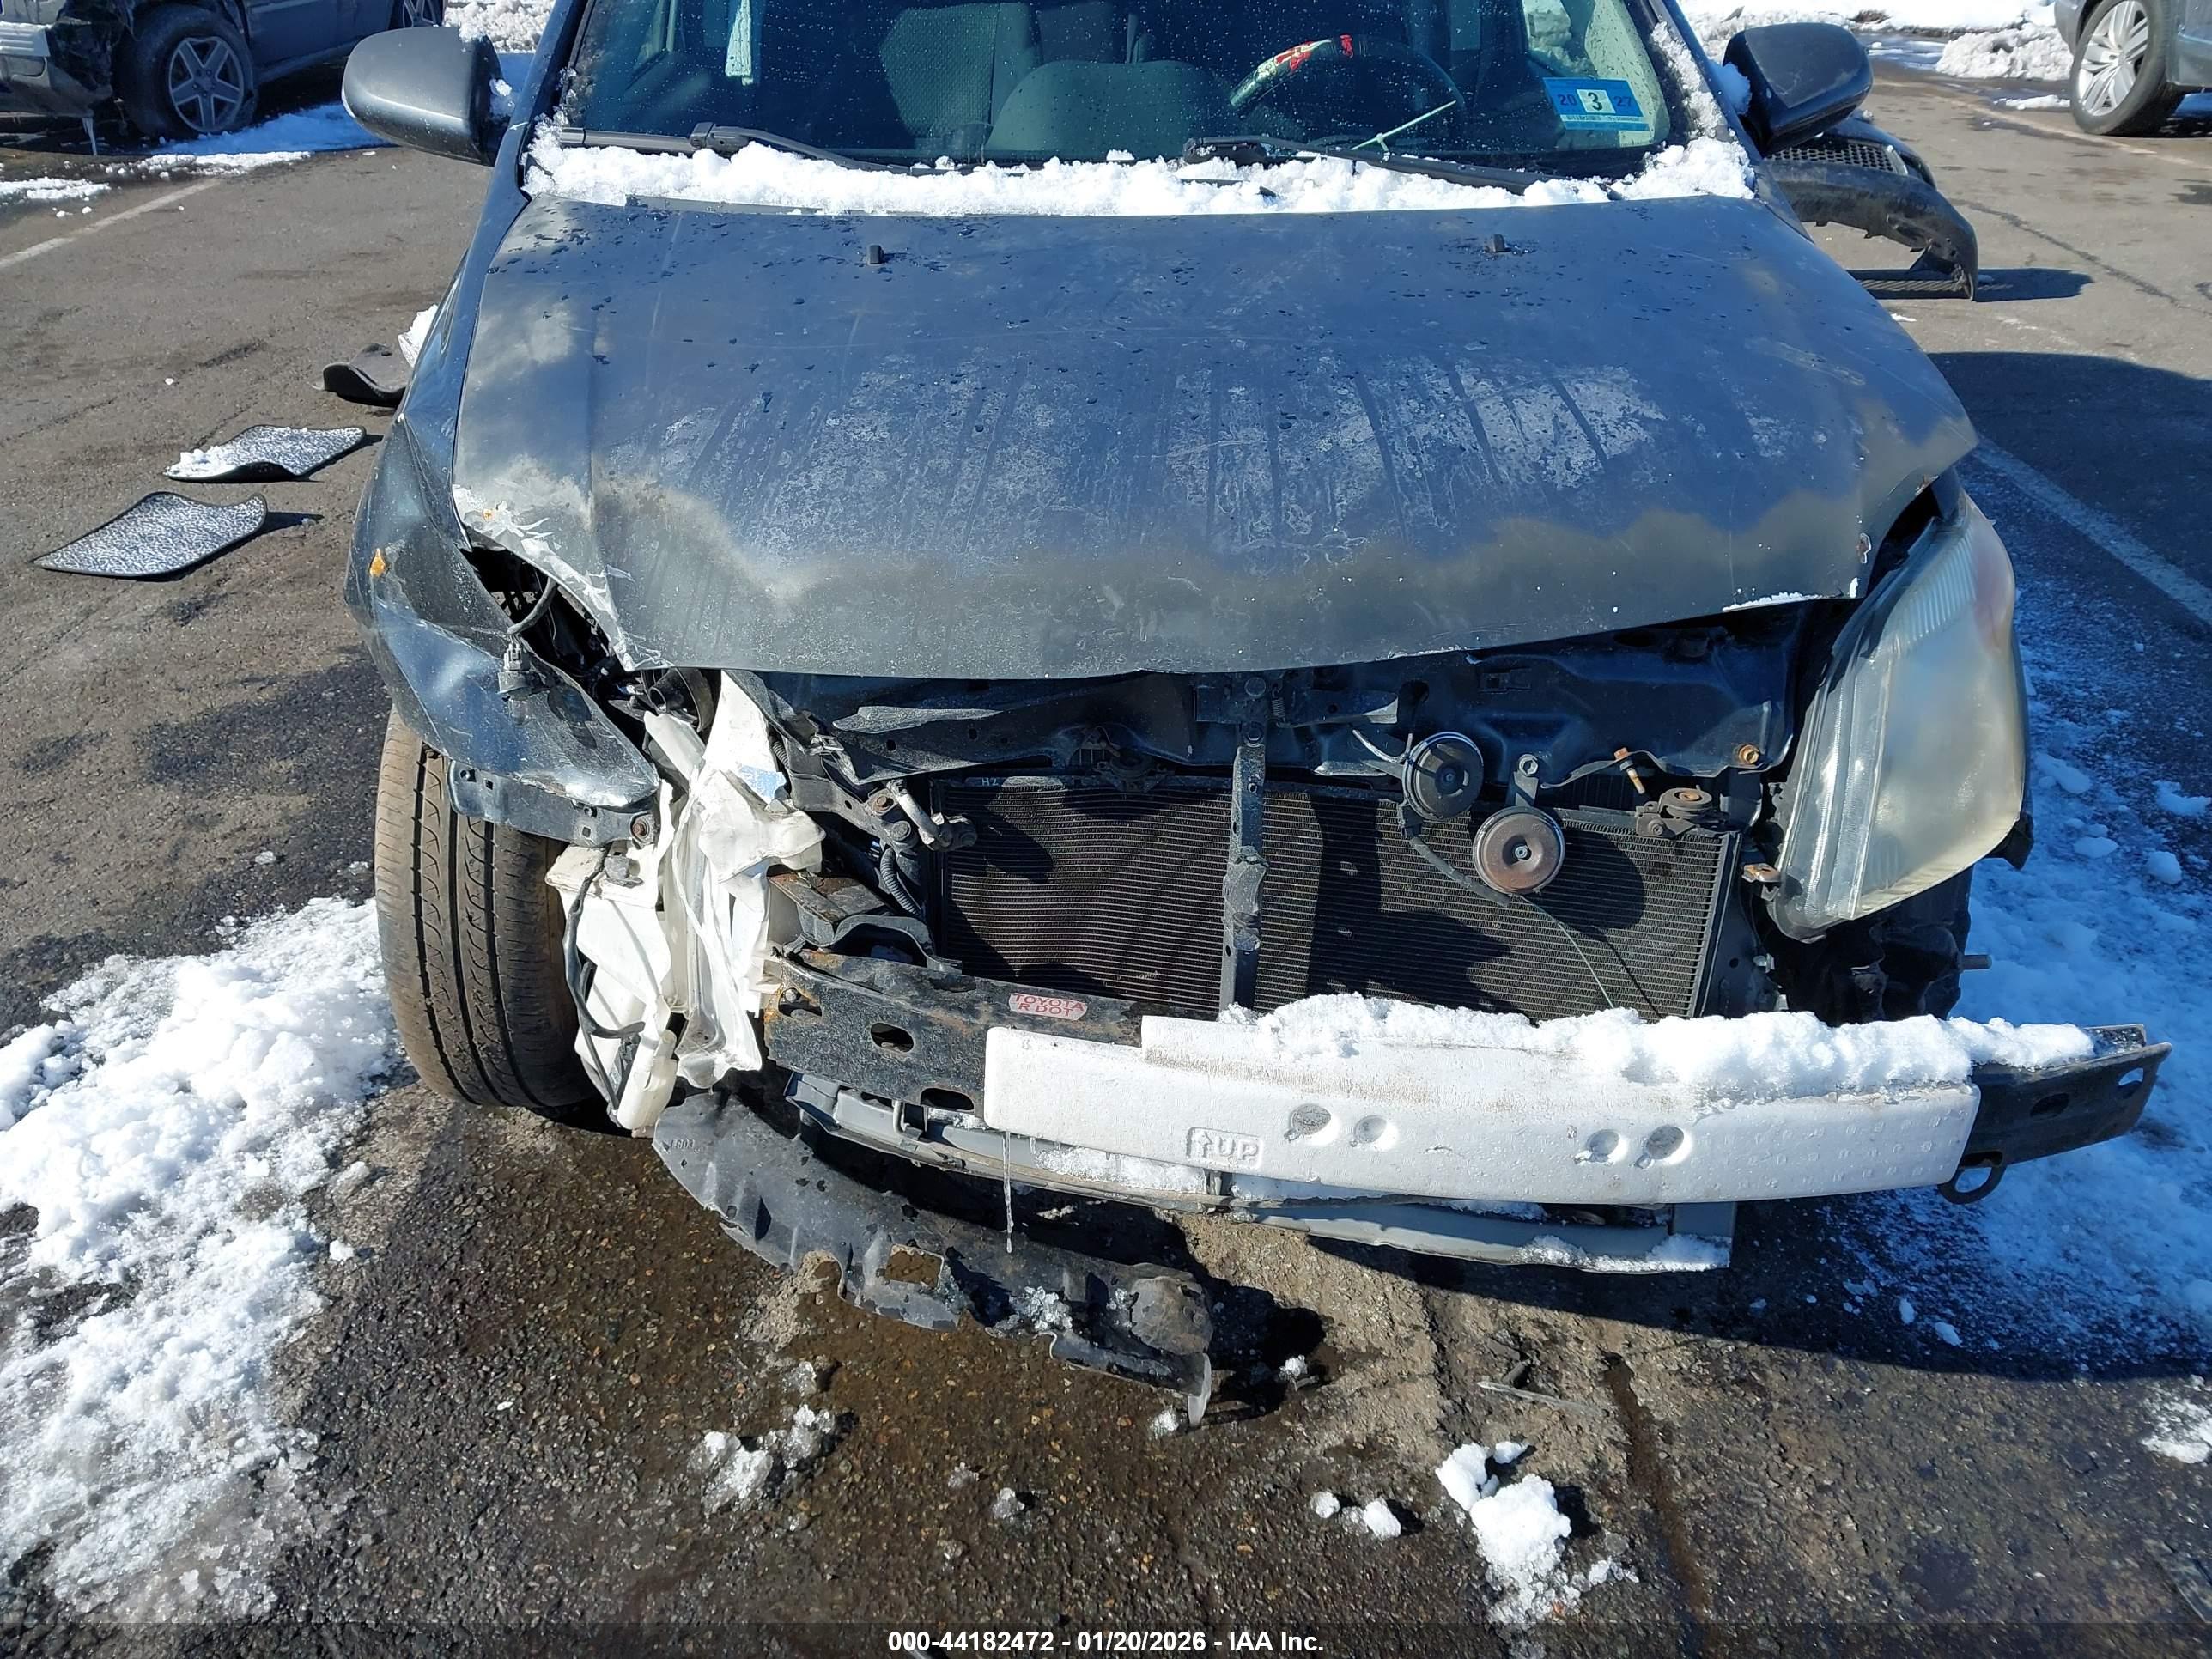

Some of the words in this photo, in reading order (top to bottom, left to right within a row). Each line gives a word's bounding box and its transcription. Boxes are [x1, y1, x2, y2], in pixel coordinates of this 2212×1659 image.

[1558, 94, 1577, 106] 20
[1587, 91, 1603, 112] 3
[1613, 95, 1632, 107] 27
[1014, 994, 1085, 1012] TOYOTA
[1018, 1003, 1031, 1012] R
[1035, 1005, 1074, 1017] DOT
[1216, 1135, 1259, 1160] UP
